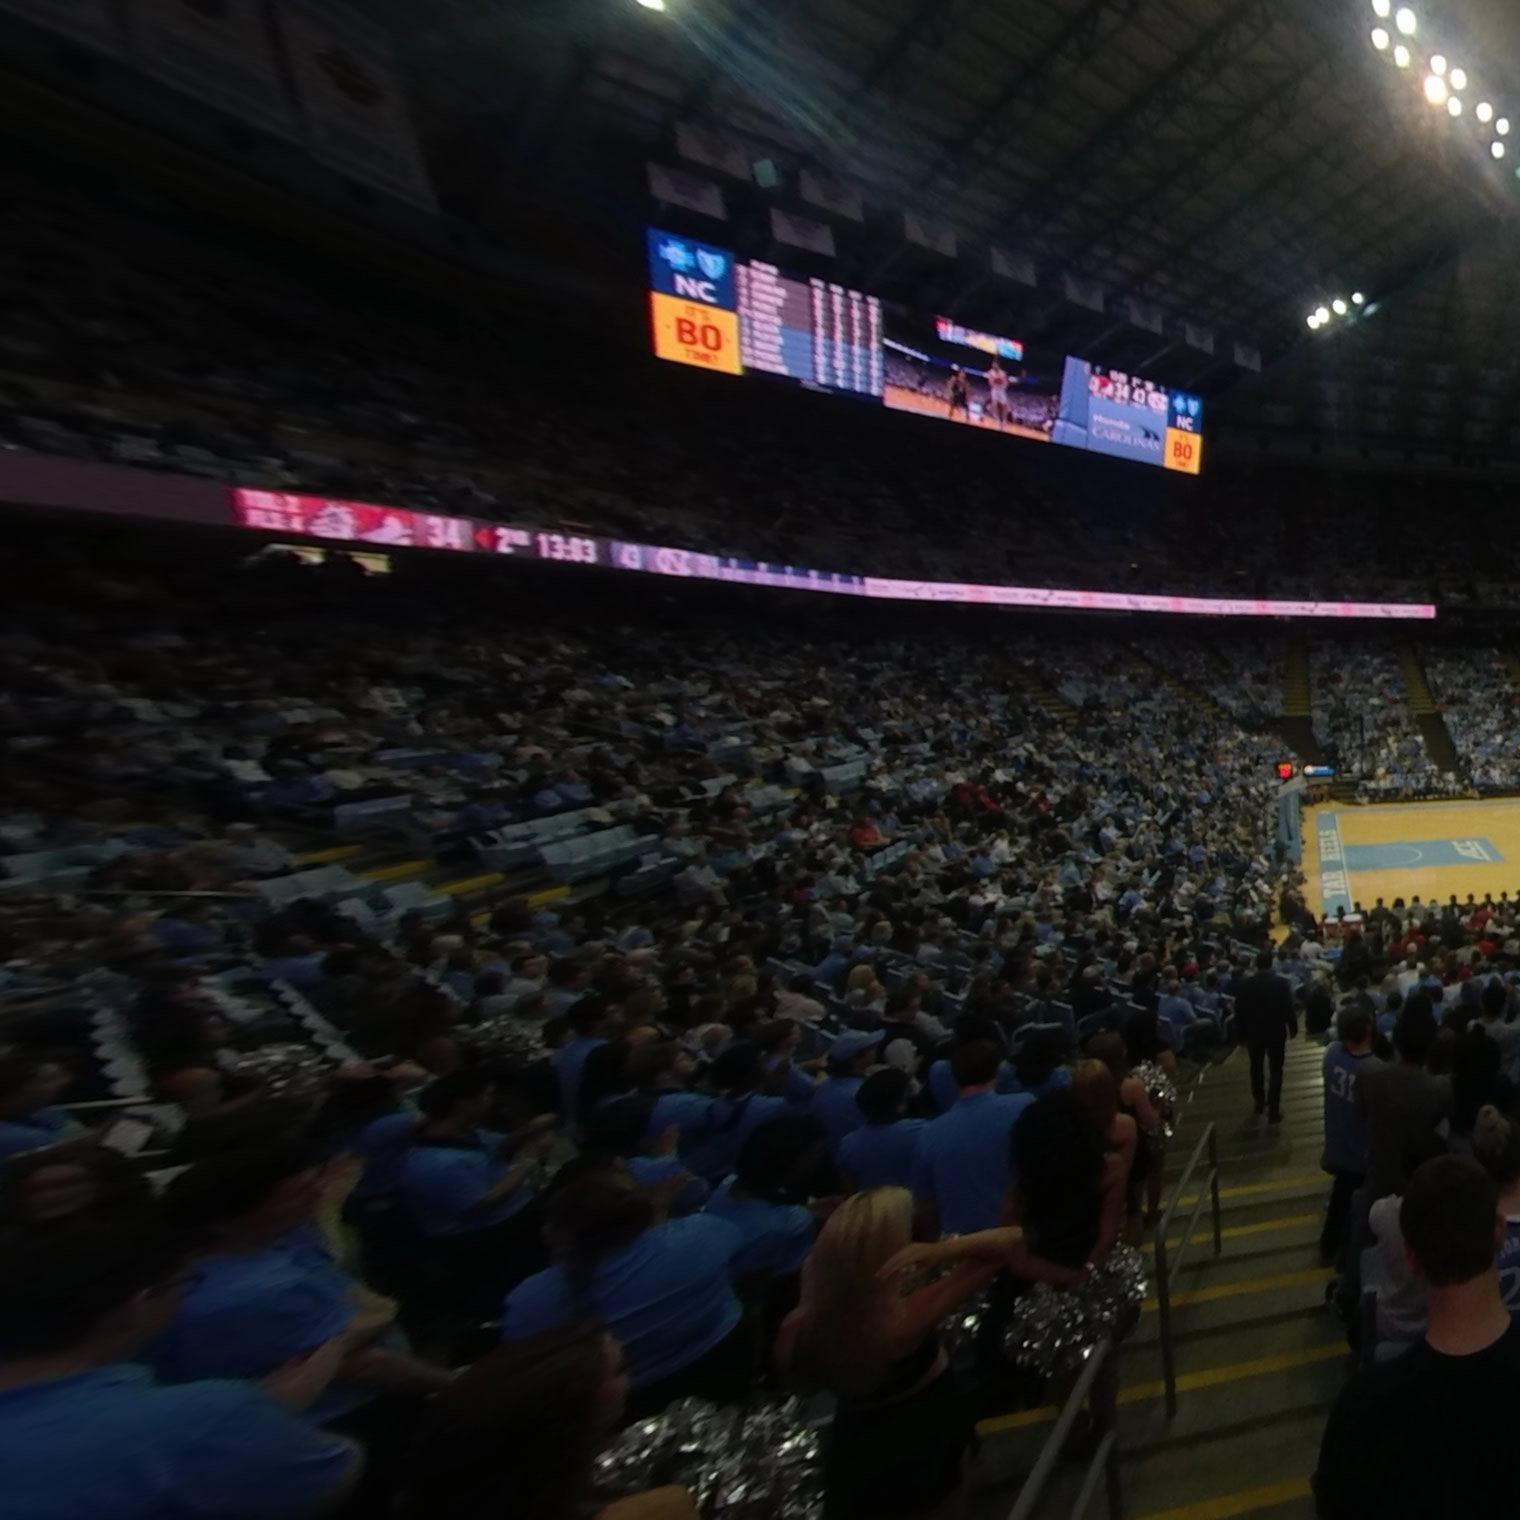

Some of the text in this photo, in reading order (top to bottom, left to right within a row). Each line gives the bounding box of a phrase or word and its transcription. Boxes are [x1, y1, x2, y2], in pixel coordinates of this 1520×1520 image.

[675, 275, 716, 303] NC
[676, 317, 722, 352] BO
[1176, 415, 1194, 432] NC
[426, 516, 462, 548] 34
[1321, 870, 1347, 899] TAR
